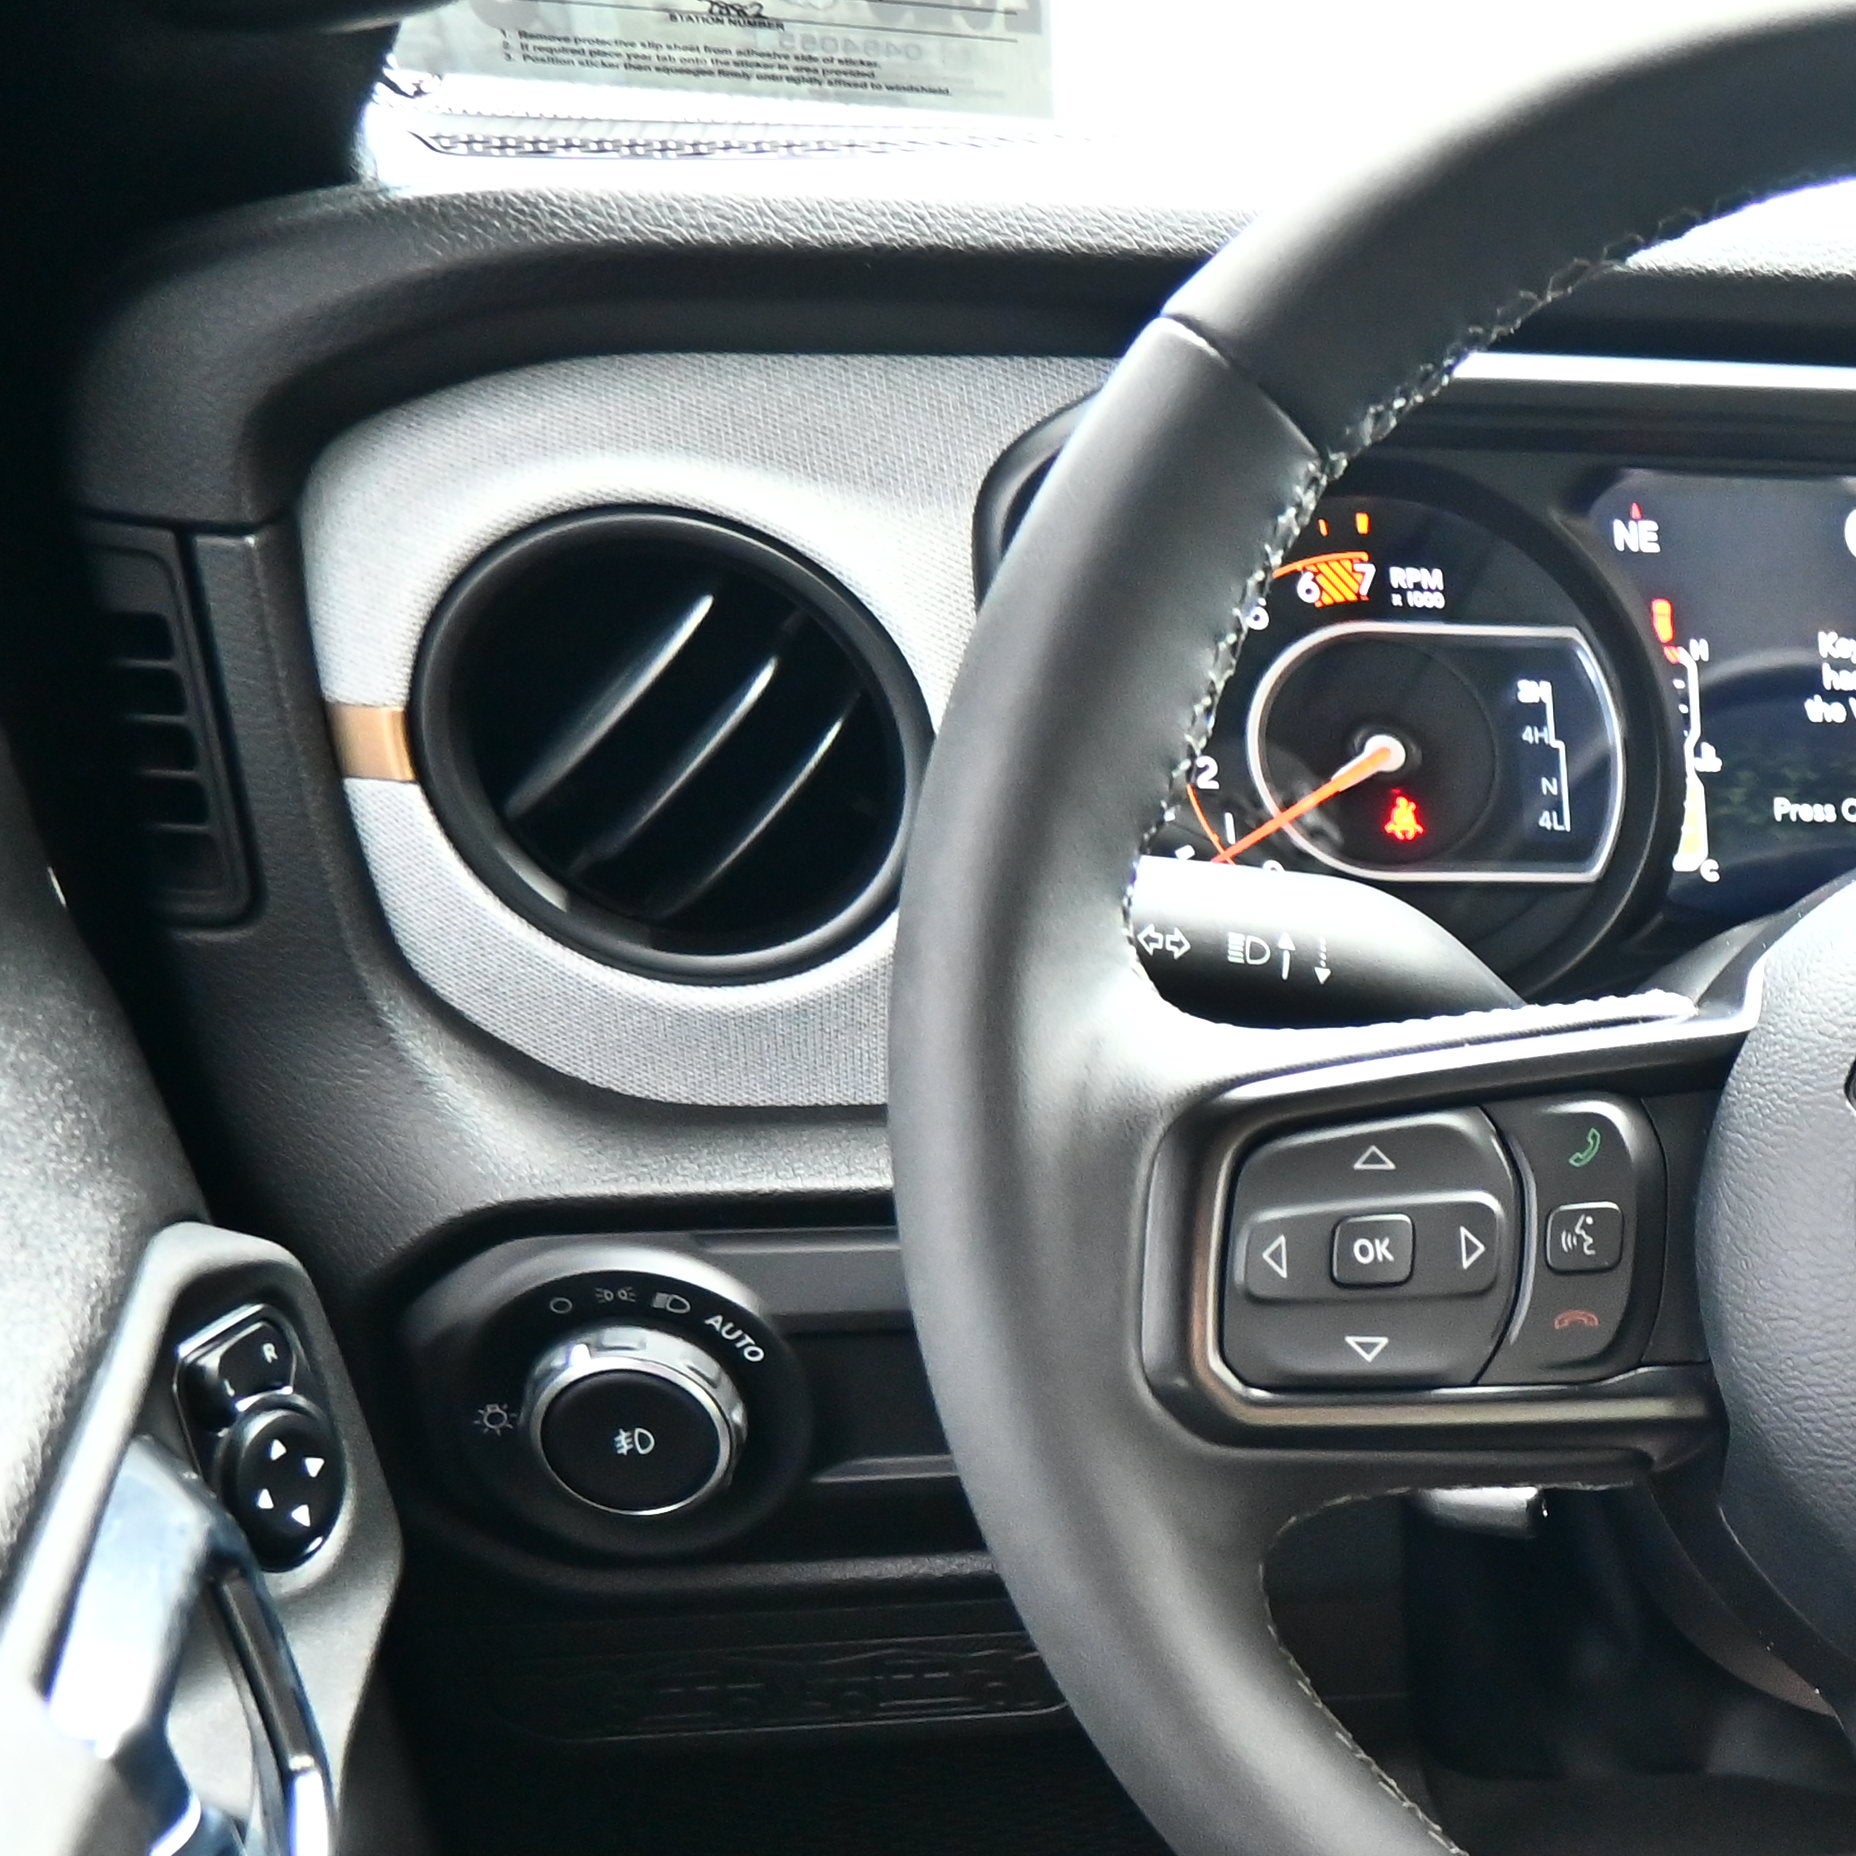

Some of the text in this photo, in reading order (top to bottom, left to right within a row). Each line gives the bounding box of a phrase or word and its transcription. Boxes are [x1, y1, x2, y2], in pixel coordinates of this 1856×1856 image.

[668, 10, 725, 25] STATION
[727, 17, 785, 31] NUMBER
[518, 30, 570, 43] Remove
[574, 37, 637, 49] protective
[640, 41, 663, 51] slip
[666, 44, 700, 53] sheet
[704, 45, 732, 55] from
[736, 49, 790, 60] adhesive
[794, 53, 819, 63] side
[533, 45, 585, 56] required
[589, 49, 622, 59] place
[656, 54, 676, 63] tab
[711, 58, 730, 67] the
[733, 60, 775, 70] sticker
[793, 66, 819, 75] area
[522, 54, 575, 66] Position
[578, 59, 620, 69] sticker
[624, 62, 652, 72] then
[655, 66, 715, 78] squeegee
[1613, 518, 1661, 553] NE
[1297, 562, 1377, 603] 6 7
[1389, 566, 1445, 590] RPM
[1407, 590, 1446, 609] 1000
[1804, 694, 1847, 724] the
[1521, 725, 1549, 745] 4H
[1196, 755, 1220, 789] 2
[1541, 776, 1558, 796] N
[1537, 810, 1566, 832] 4L
[1773, 796, 1837, 823] Press
[1353, 1238, 1395, 1266] OK
[705, 1315, 765, 1364] AUTO
[262, 1343, 280, 1364] R
